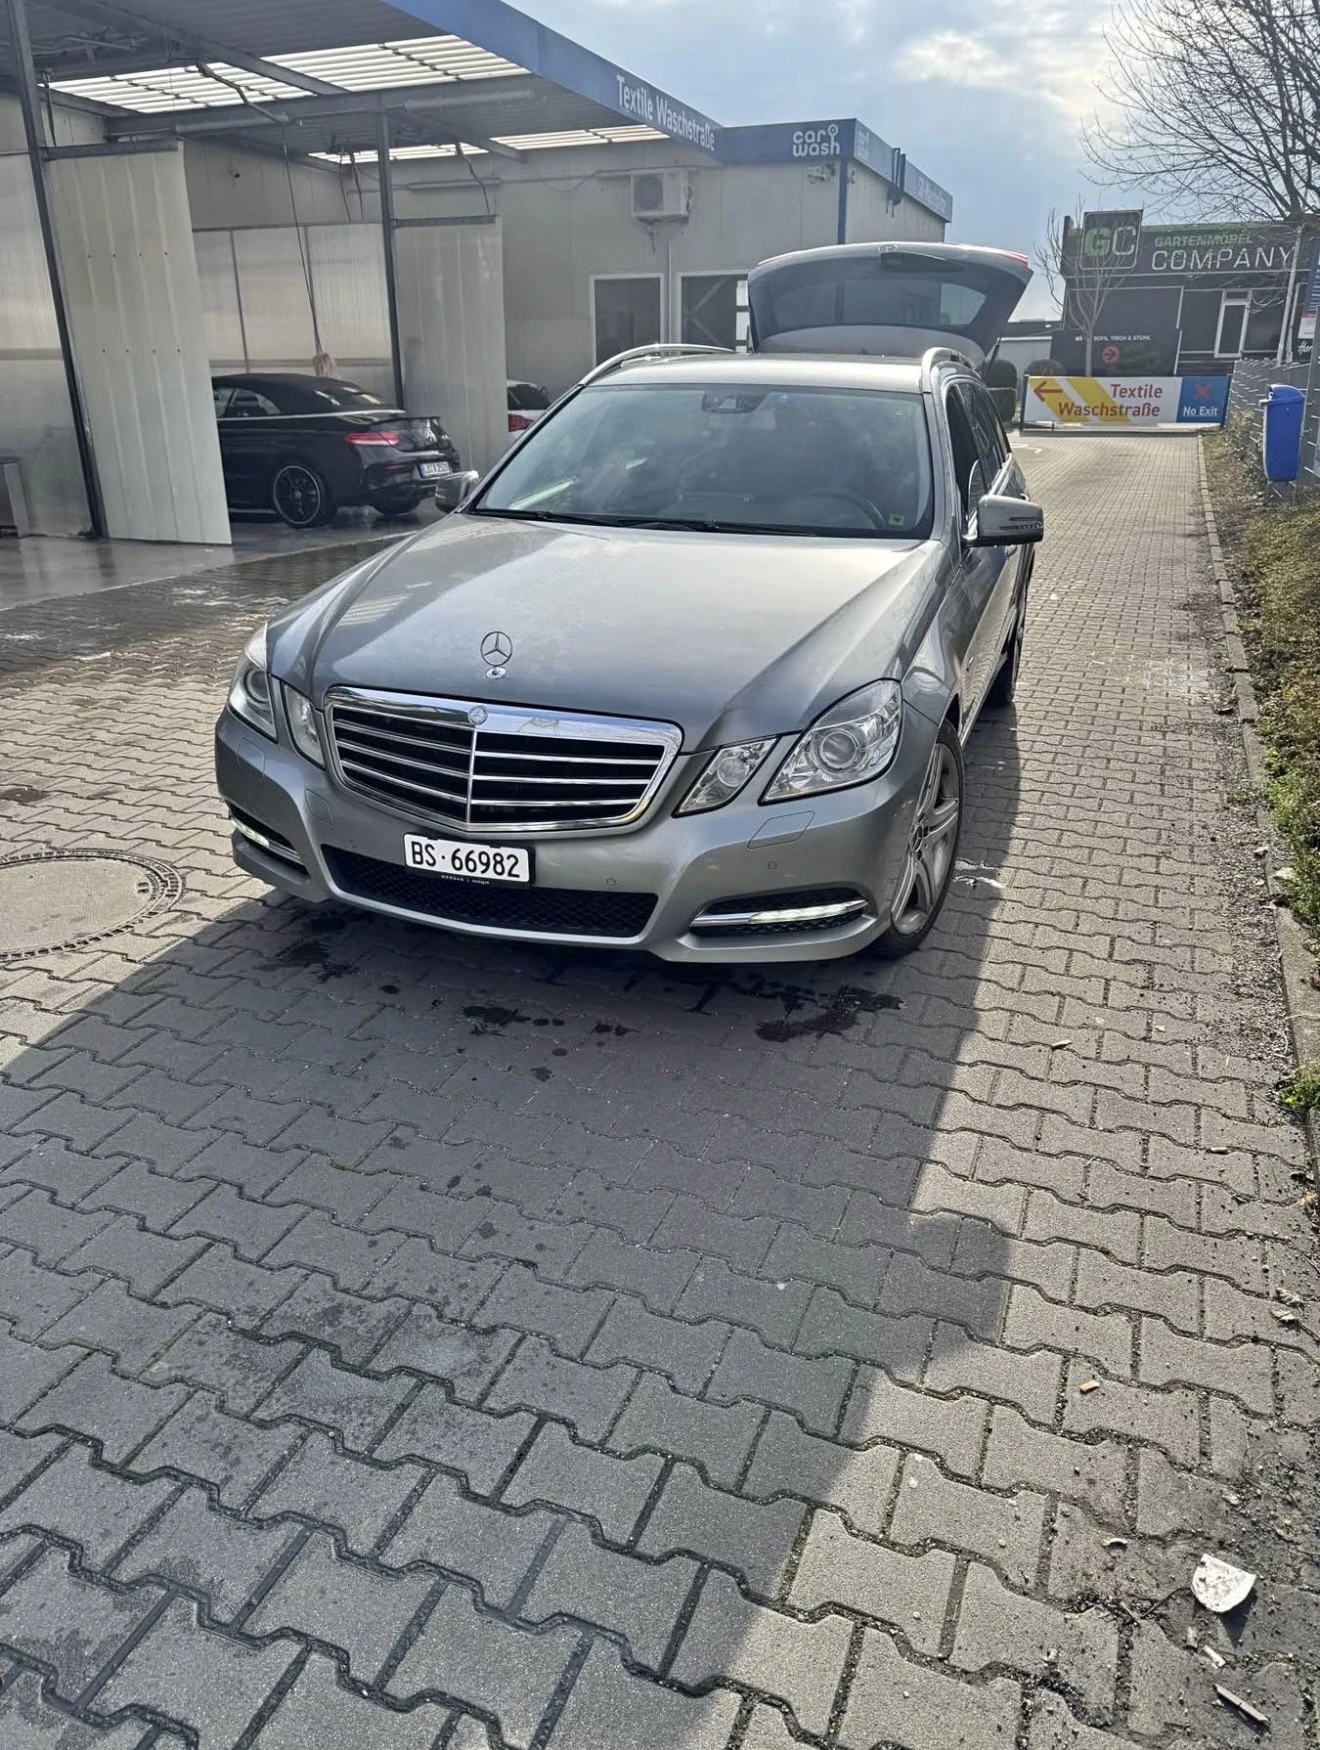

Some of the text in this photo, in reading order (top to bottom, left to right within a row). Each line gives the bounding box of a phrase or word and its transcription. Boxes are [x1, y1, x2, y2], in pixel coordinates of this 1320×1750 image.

[616, 75, 715, 152] Textile Waschstraße
[793, 130, 826, 144] car
[793, 133, 840, 158] wash
[1084, 227, 1136, 257] GC
[1152, 246, 1296, 271] COMPANY
[1110, 384, 1163, 399] Textile
[1058, 401, 1160, 417] Waschstraße
[1183, 405, 1219, 416] No Exit
